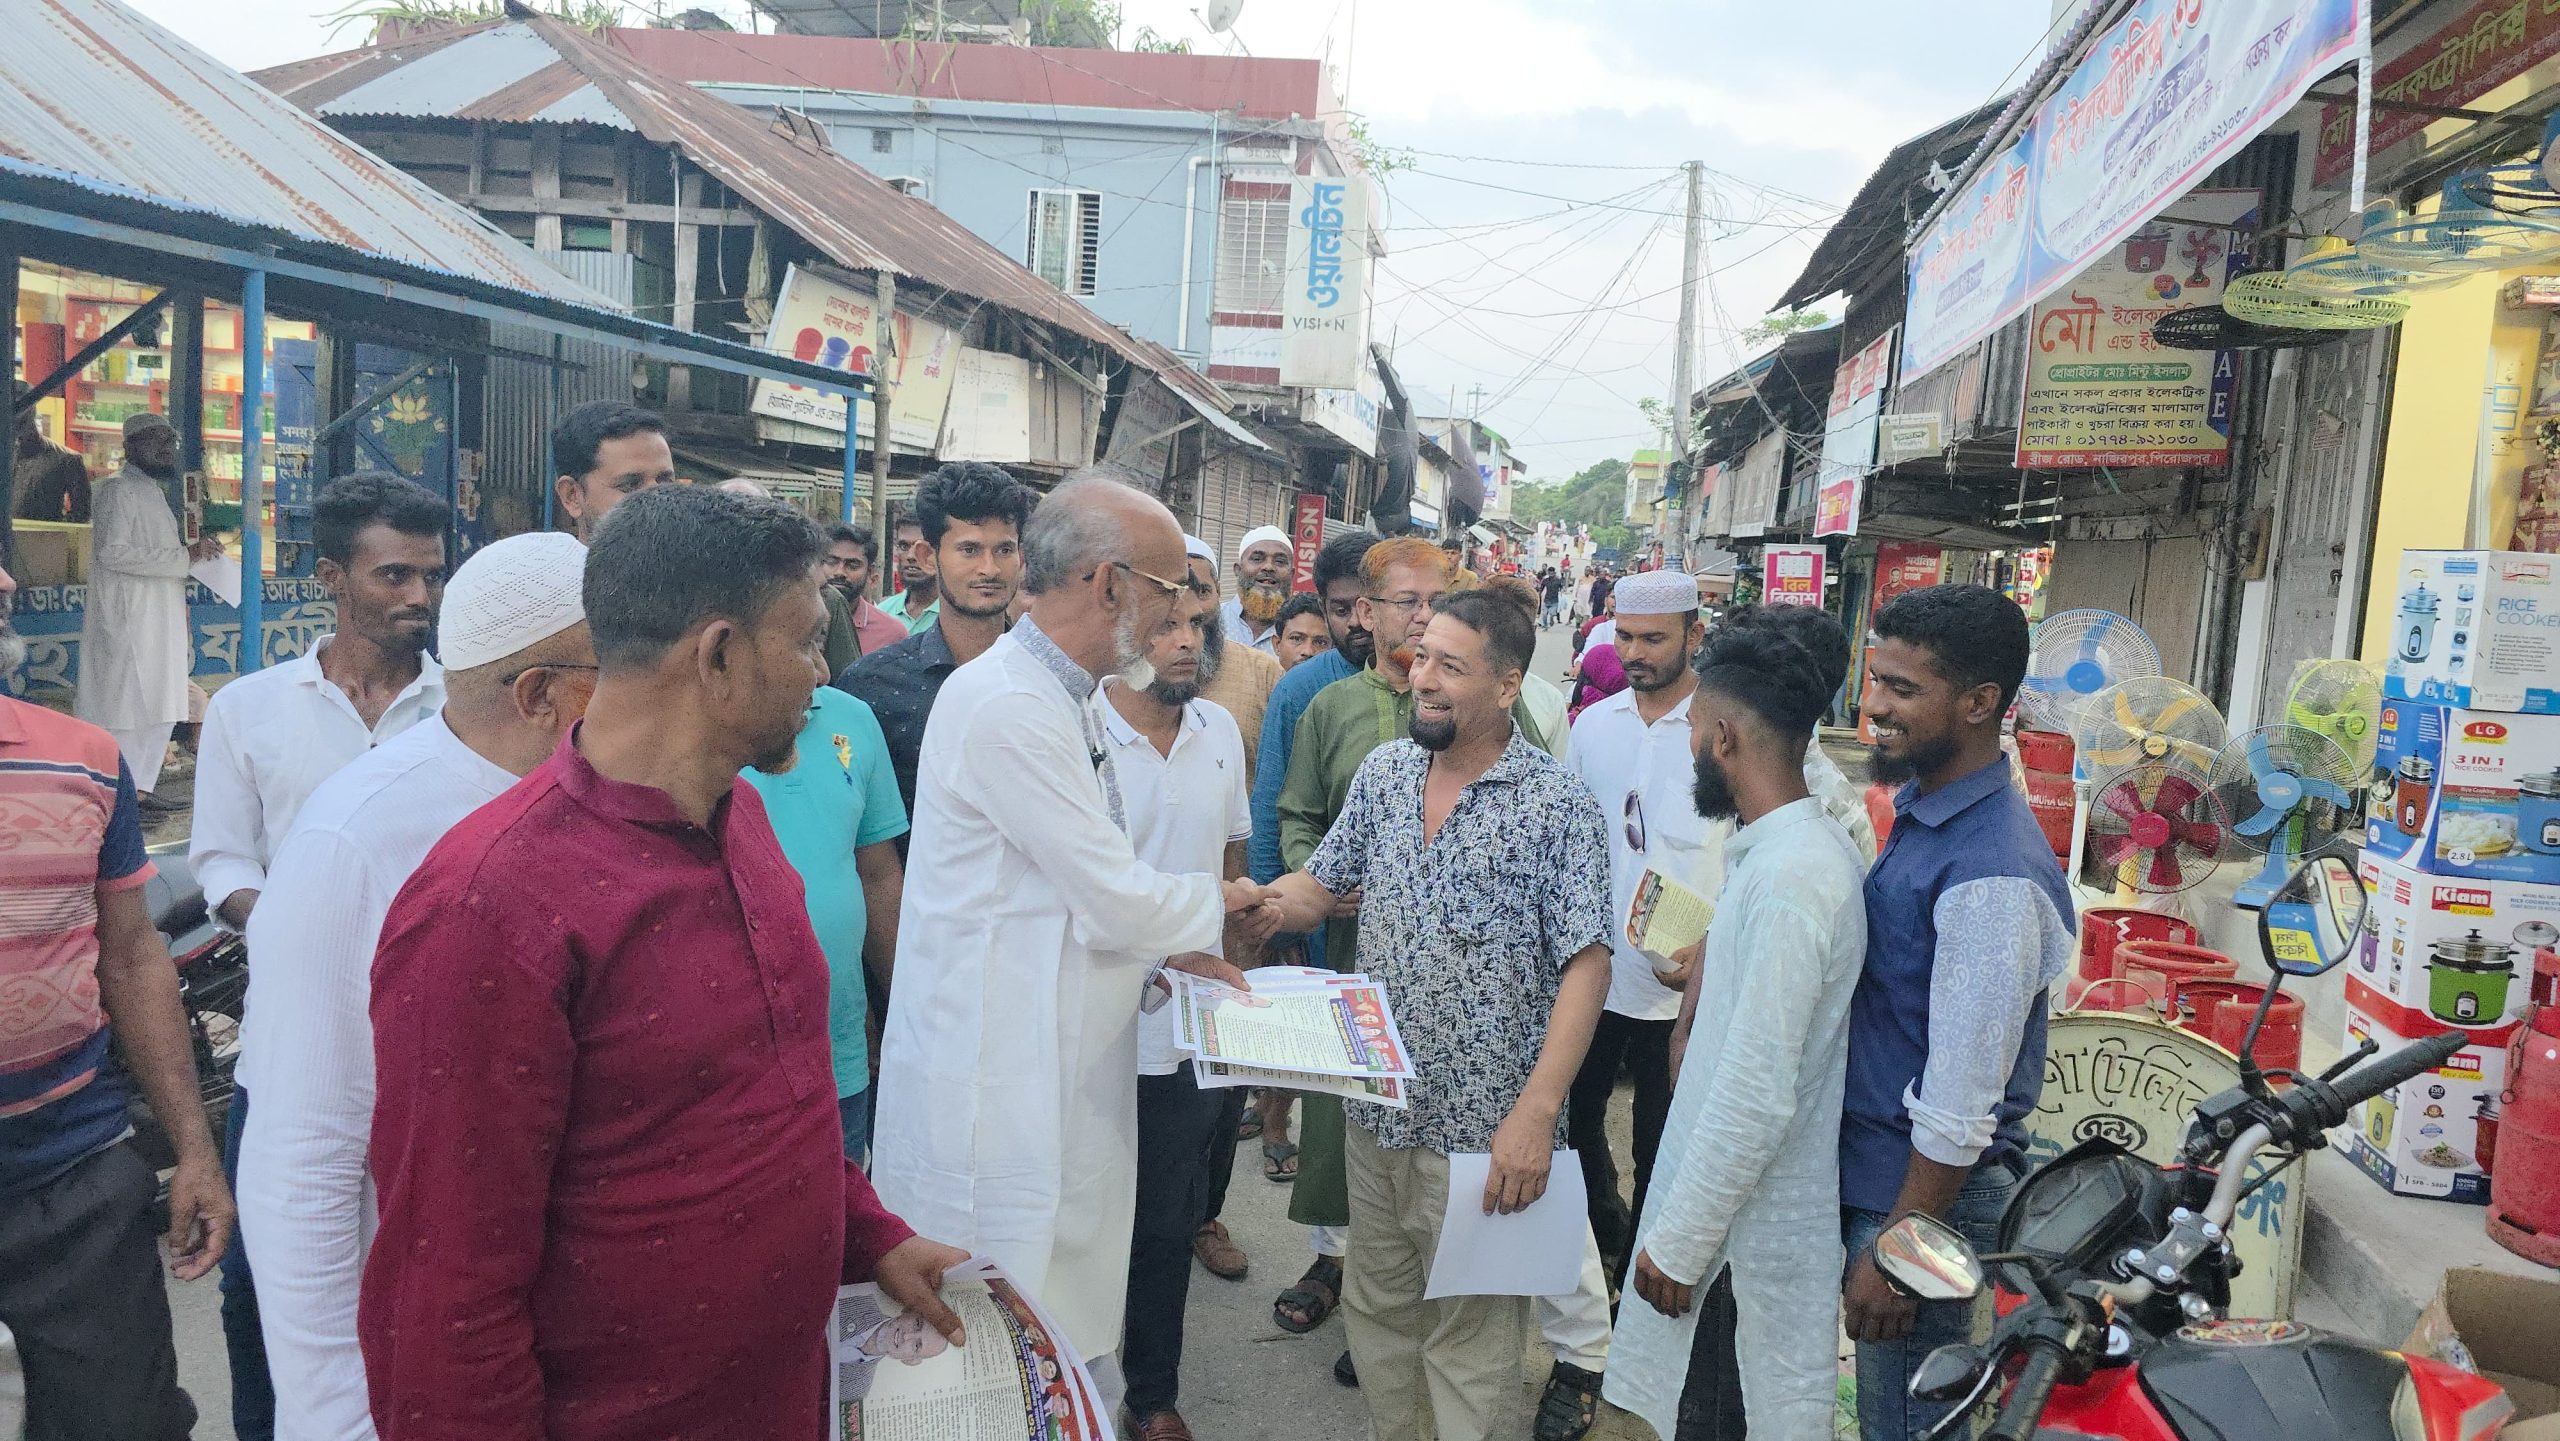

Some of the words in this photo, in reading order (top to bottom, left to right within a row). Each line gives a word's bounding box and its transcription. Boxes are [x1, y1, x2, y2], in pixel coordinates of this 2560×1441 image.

[1301, 182, 1346, 308] ওয়ালটন
[2038, 289, 2105, 354] মৌ
[2108, 334, 2134, 351] এন্ড
[2050, 364, 2100, 379] প্রোপ্রাইটর
[2104, 365, 2125, 378] মোঃ
[2128, 363, 2150, 379] মিন্টু
[2152, 363, 2190, 378] ইসলাম
[2030, 387, 2068, 399] এখানে
[2073, 388, 2103, 398] সকল
[2108, 387, 2141, 399] প্রকার
[2028, 405, 2054, 415] এবং
[2152, 403, 2204, 413] মালামাল
[2027, 417, 2070, 430] পাইকারী
[2075, 421, 2083, 429] ও
[2089, 420, 2114, 432] খুচরা
[2118, 417, 2149, 429] বিক্রয়
[2154, 419, 2174, 429] করা
[2178, 419, 2194, 429] হয়
[2025, 434, 2058, 446] মোবা
[2077, 433, 2198, 445] ০১৭৭৪-৯২১০৩০
[2029, 451, 2052, 466] ব্রীজ
[1297, 508, 1319, 583] VISION
[1783, 577, 1812, 593] বিল
[2498, 597, 2538, 612] RICE
[2456, 754, 2466, 764] 3
[2471, 756, 2491, 766] IN
[2498, 757, 2504, 766] 1
[2455, 764, 2471, 772] RICE
[2028, 794, 2056, 806] AMUNA
[2057, 797, 2073, 807] GAS
[2434, 887, 2489, 906] Kiam
